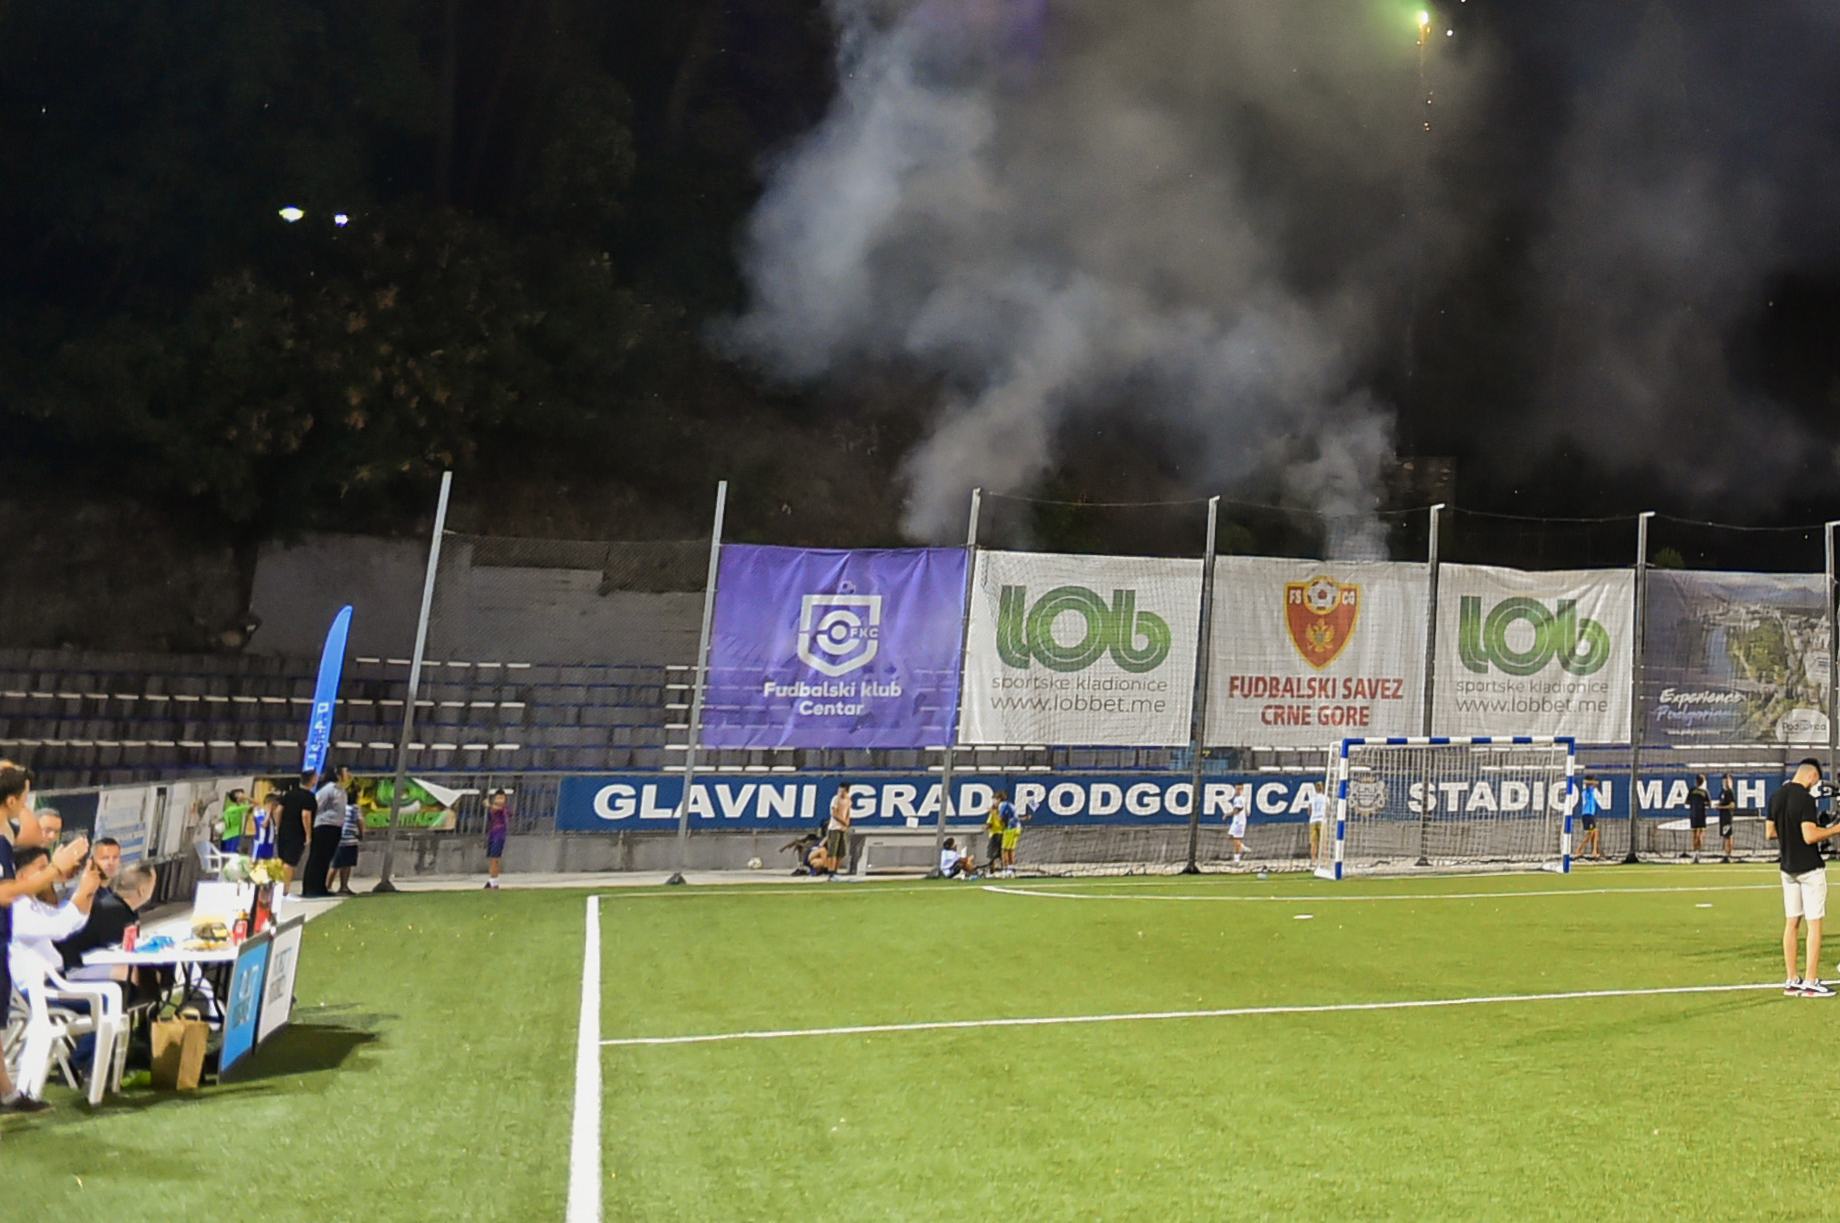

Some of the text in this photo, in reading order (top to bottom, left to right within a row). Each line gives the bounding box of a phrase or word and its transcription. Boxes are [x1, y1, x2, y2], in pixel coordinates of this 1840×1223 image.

[1289, 589, 1302, 604] FS
[763, 682, 901, 698] Fudbalski klub
[992, 676, 1168, 693] sportske kladionice
[1229, 676, 1404, 700] FUDBALSKI SAVEZ
[1456, 680, 1609, 695] sportske kladionice
[799, 700, 865, 716] Centar
[991, 694, 1166, 713] www.lobbet.me
[1456, 696, 1608, 713] www.lobbet.me
[1261, 705, 1370, 726] CRNE GORE
[593, 784, 817, 820] GLAVNI
[849, 783, 994, 819] GRAD
